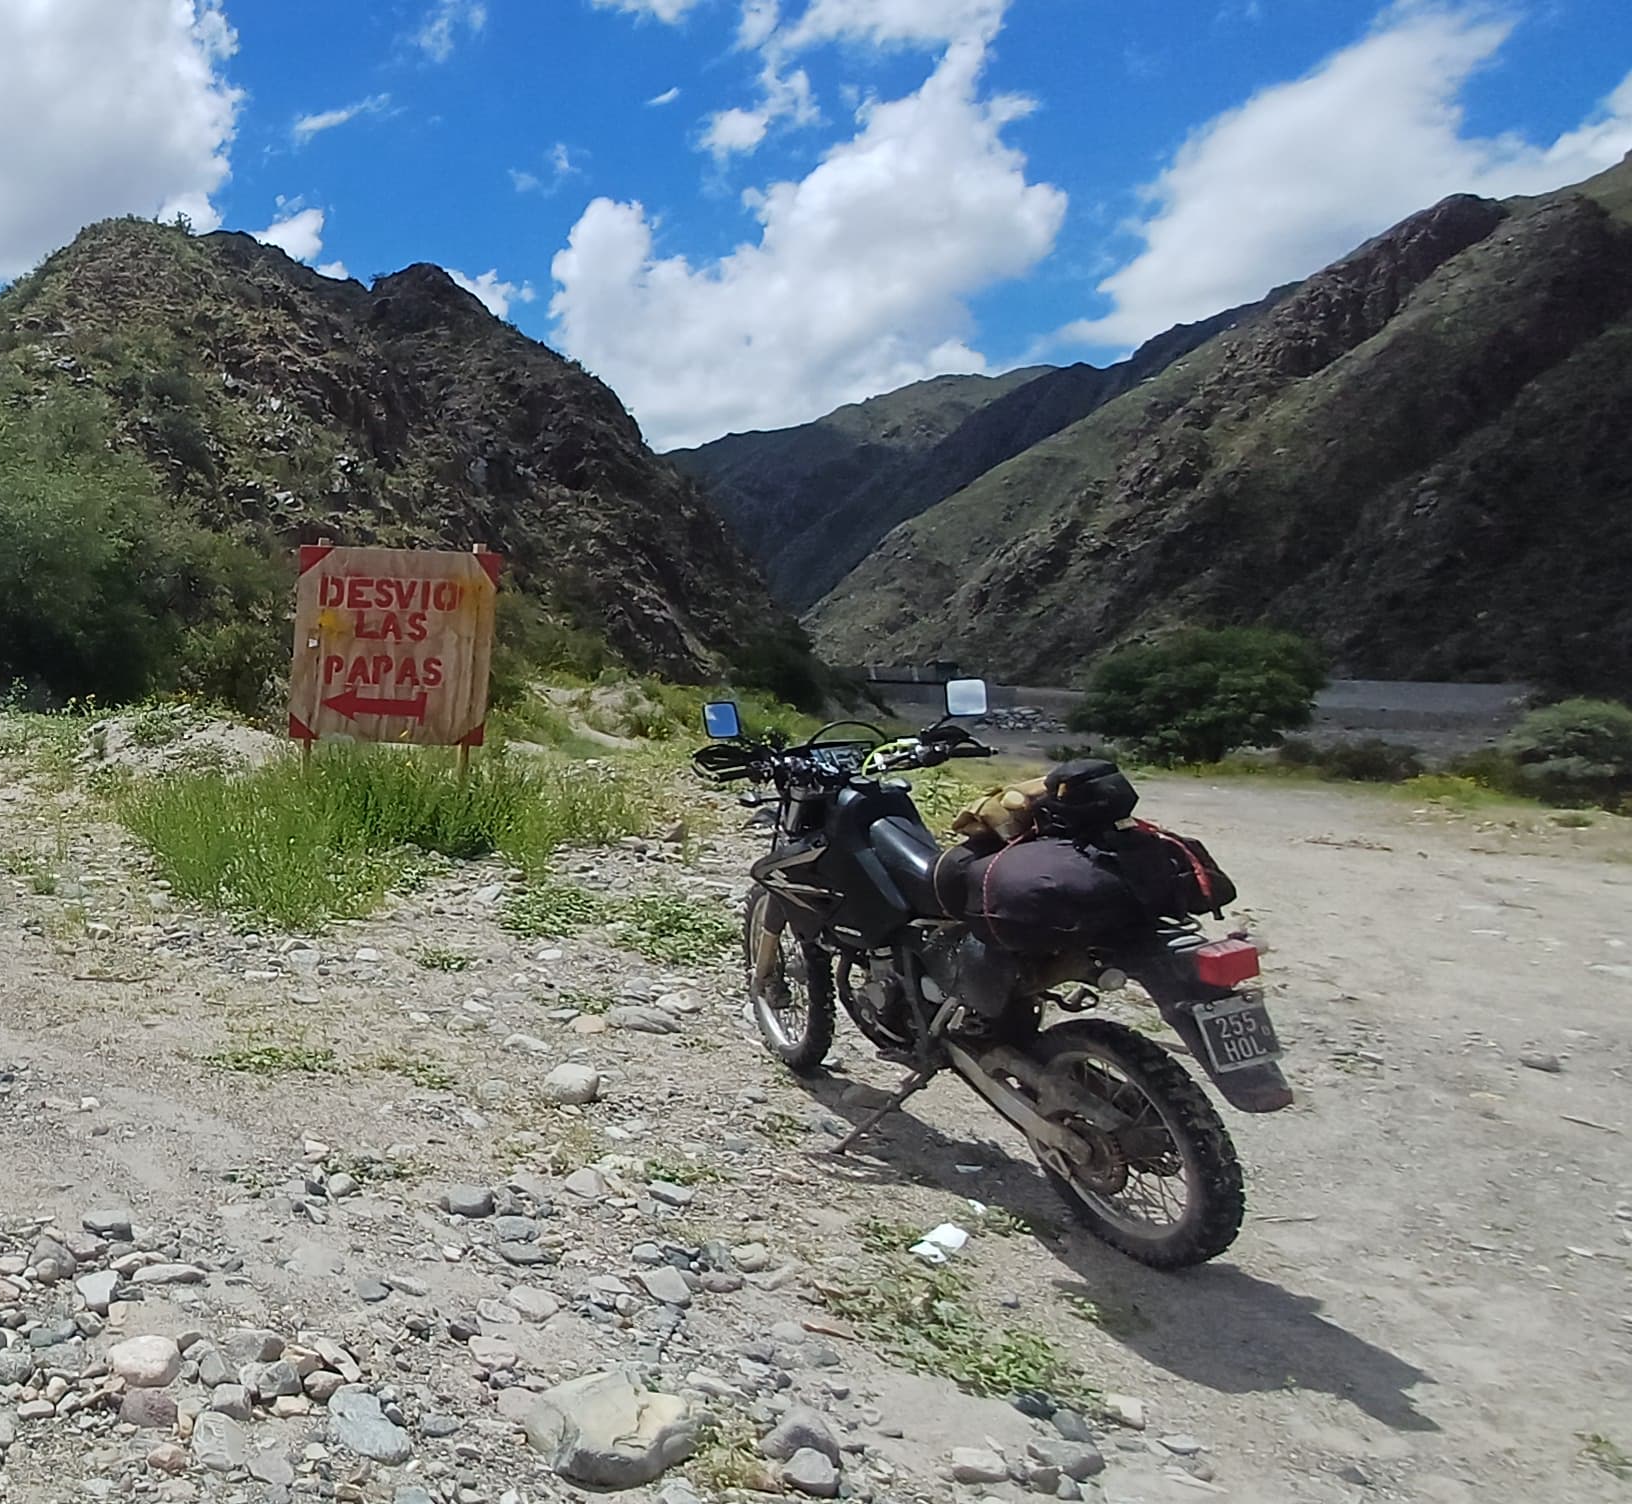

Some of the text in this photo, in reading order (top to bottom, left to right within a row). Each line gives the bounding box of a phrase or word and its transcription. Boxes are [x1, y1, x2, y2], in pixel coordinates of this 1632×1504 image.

[319, 575, 461, 612] DESVIO
[355, 610, 427, 642] LAS
[324, 655, 443, 686] PAPAS
[1215, 1012, 1256, 1038] 255
[1224, 1035, 1267, 1061] HOL
